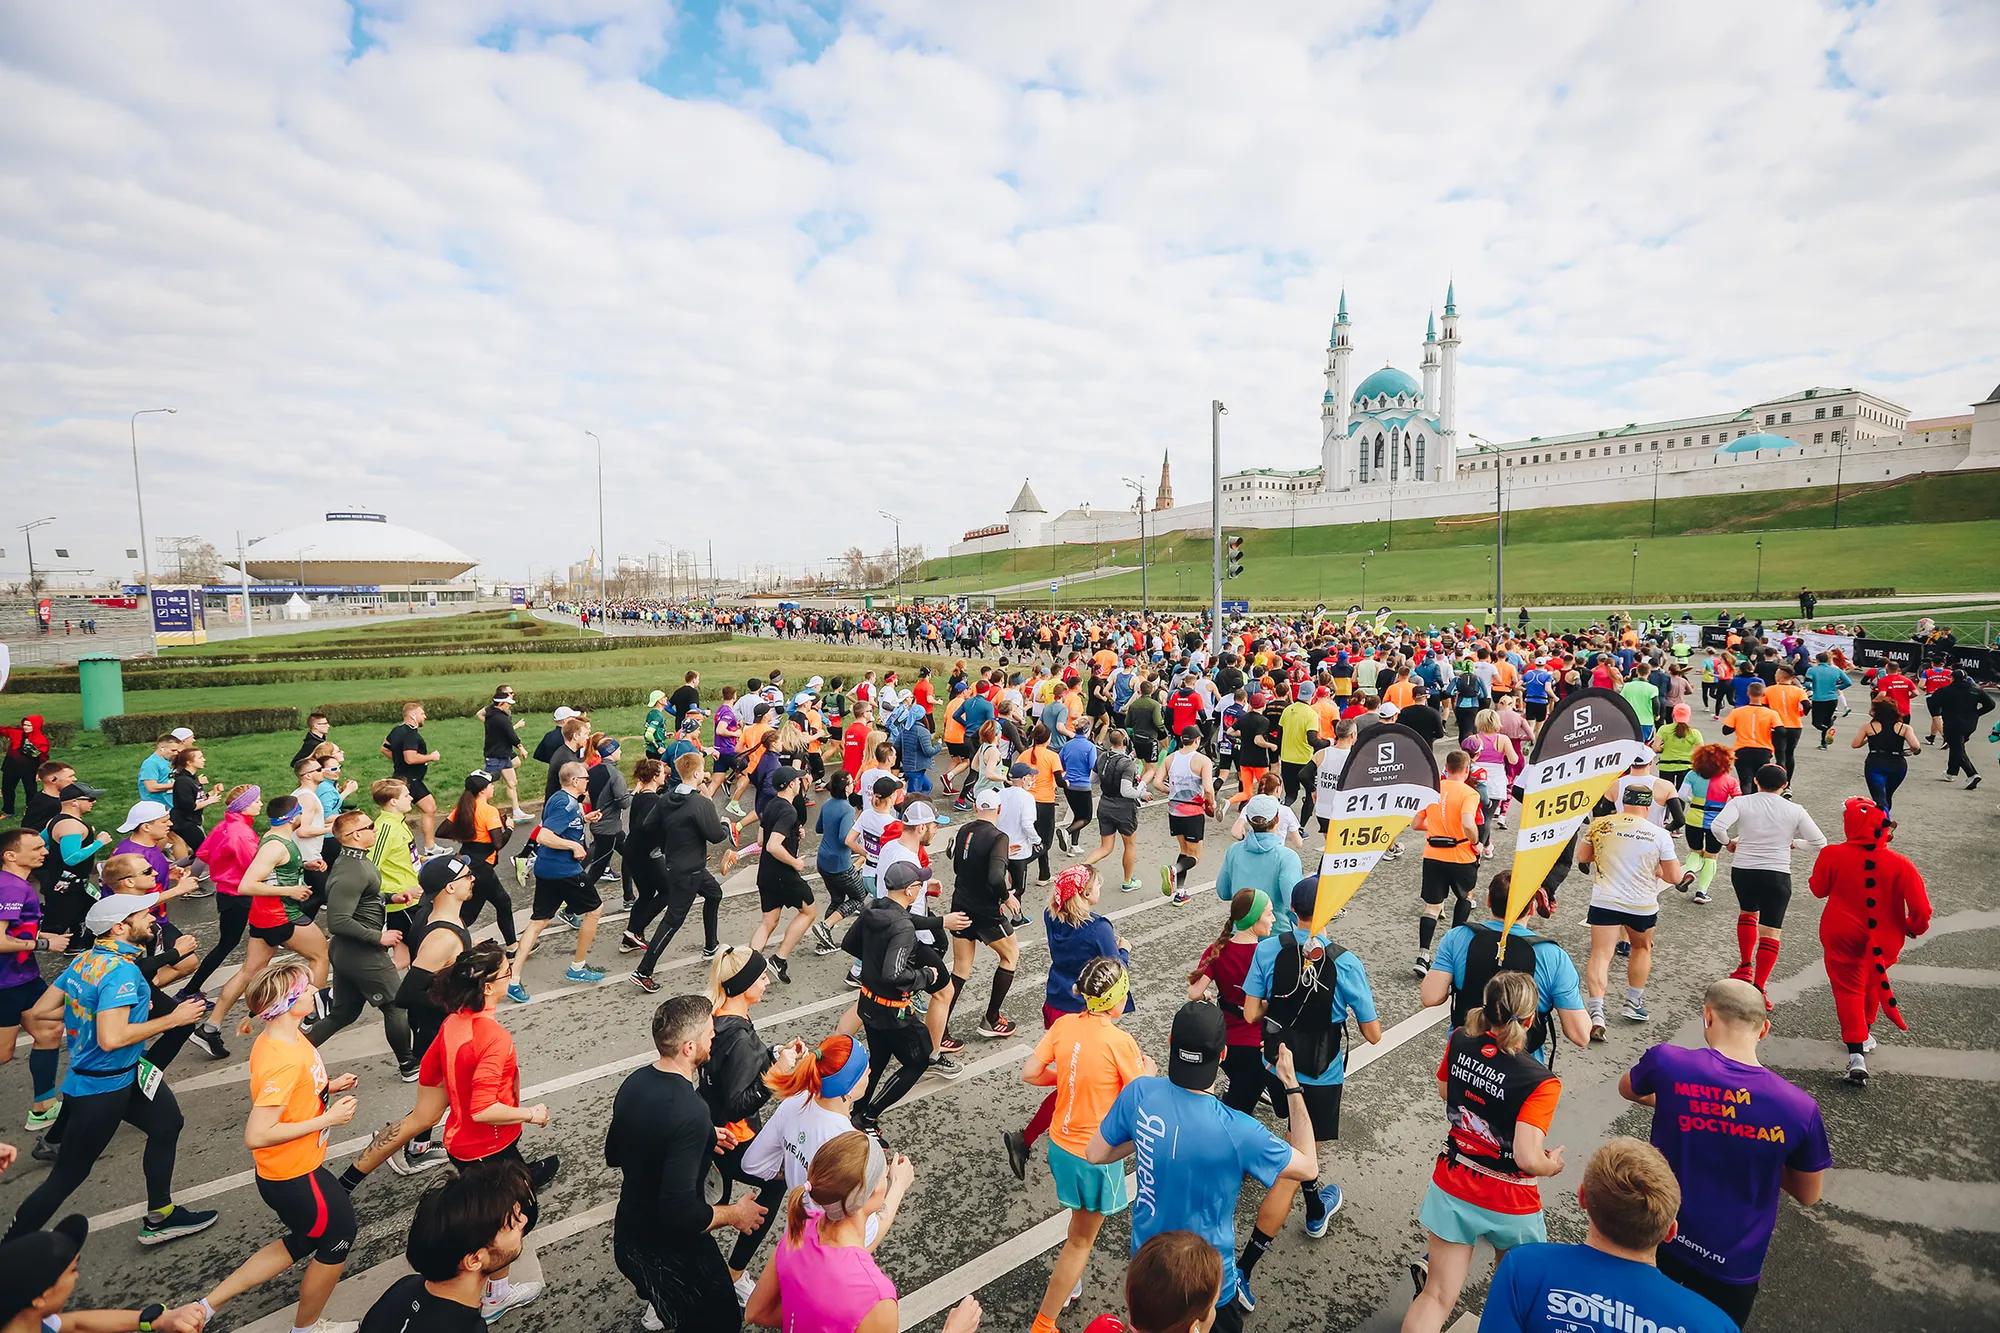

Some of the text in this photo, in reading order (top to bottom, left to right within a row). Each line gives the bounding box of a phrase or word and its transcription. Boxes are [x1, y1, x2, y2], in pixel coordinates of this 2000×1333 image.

[1711, 633, 1727, 641] TIME
[1864, 649, 1910, 661] TIME MAN
[1959, 657, 1980, 669] MAN
[1563, 724, 1602, 742] salomon
[1368, 762, 1404, 775] salomon
[1541, 756, 1586, 784] 21.1
[1346, 792, 1388, 813] 21.1
[1535, 790, 1584, 819] 1:50
[1340, 826, 1383, 846] 1:50
[1530, 828, 1555, 843] 5:13
[1333, 858, 1358, 869] 5:13
[1457, 1052, 1506, 1085] НАТАЛЬЯ
[1450, 1064, 1505, 1101] СНЕГИРЁВА
[1674, 1081, 1751, 1105] МЕЧТАЙ
[1136, 1106, 1167, 1217] Яндекс
[1673, 1233, 1726, 1264] demy.ru
[1547, 1290, 1677, 1333] softlin
